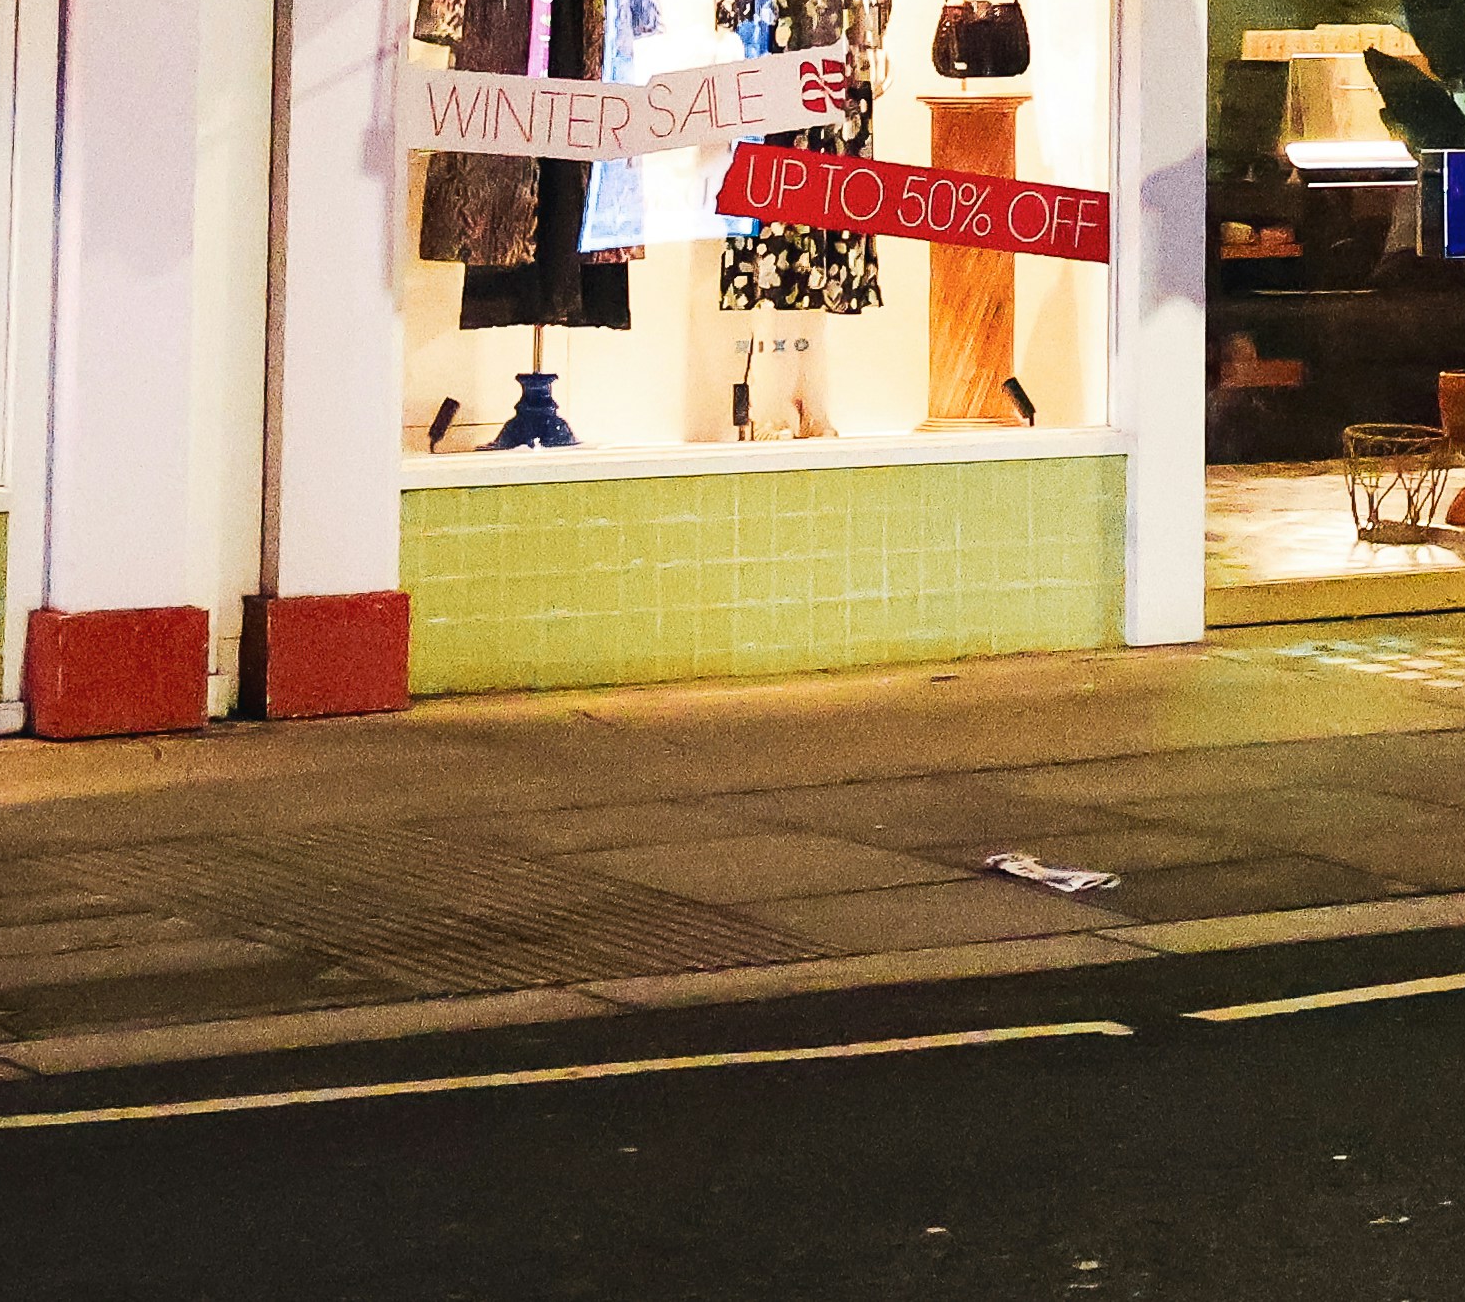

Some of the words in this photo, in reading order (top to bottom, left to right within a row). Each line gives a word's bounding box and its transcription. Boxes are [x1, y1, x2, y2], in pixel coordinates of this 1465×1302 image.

[426, 82, 631, 149] WINTER
[647, 69, 766, 138] SALE
[746, 154, 808, 209] UP
[819, 162, 884, 221] TO
[897, 175, 992, 237] 50%
[1007, 190, 1100, 248] OFF
